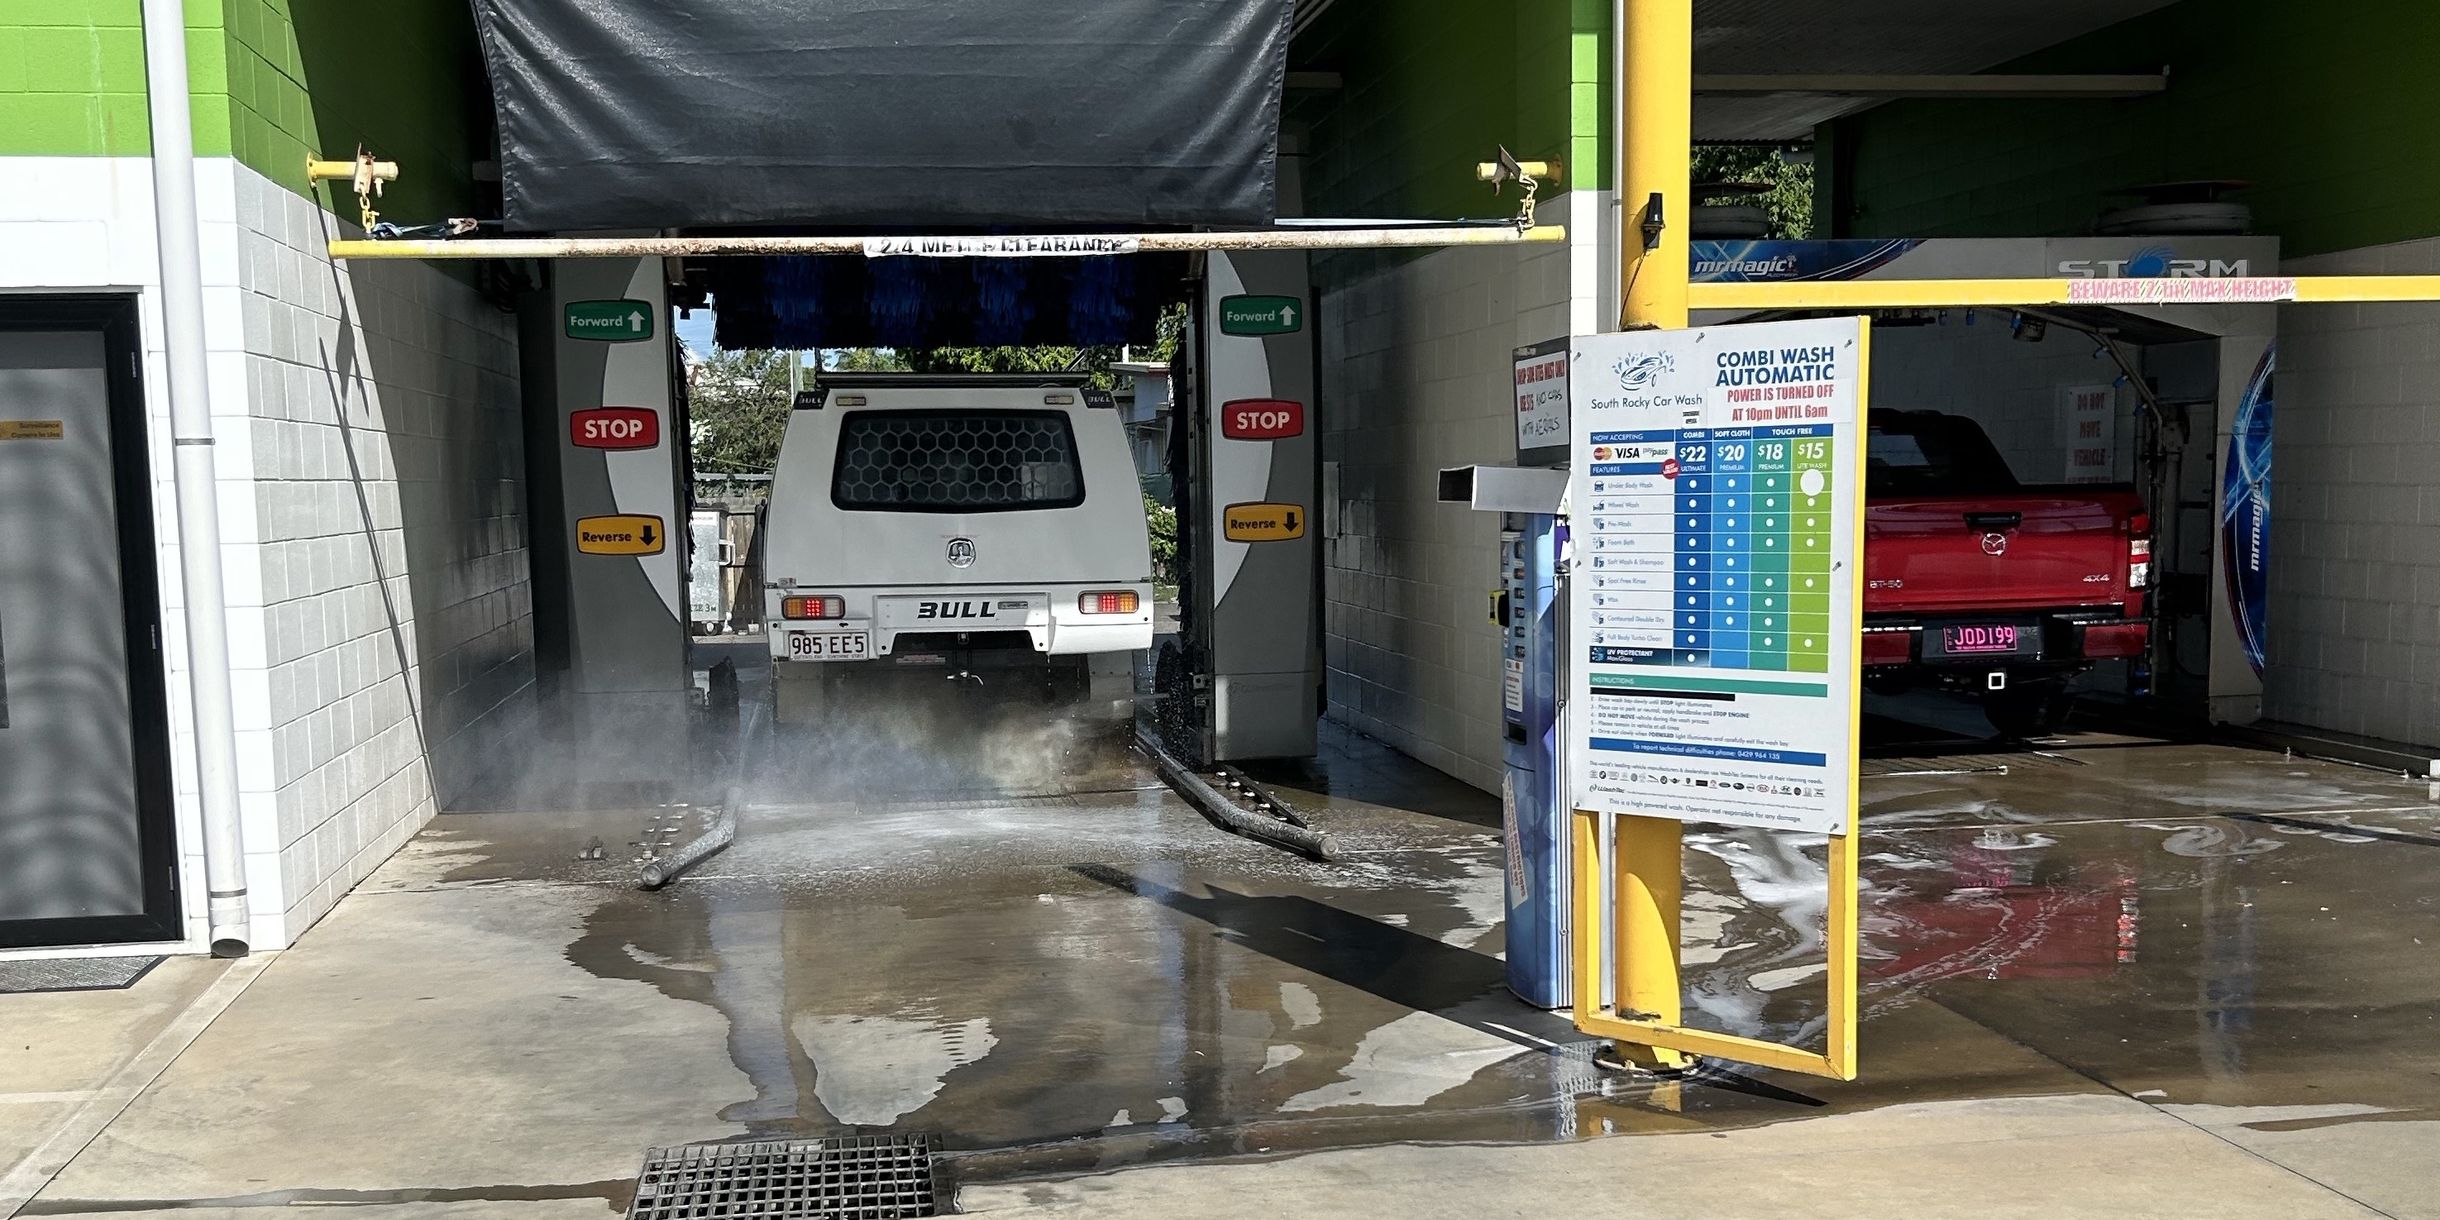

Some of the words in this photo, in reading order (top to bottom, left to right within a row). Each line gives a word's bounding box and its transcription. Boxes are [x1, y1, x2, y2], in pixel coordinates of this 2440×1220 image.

[1695, 256, 1787, 276] mrmagic
[2071, 280, 2140, 299] BEWARE
[2190, 280, 2226, 297] MAX
[2232, 280, 2292, 297] HEIGHT
[571, 315, 623, 327] Forward
[1227, 311, 1275, 322] Forward
[1717, 349, 1774, 368] COMBI
[1780, 346, 1834, 364] WASH
[1716, 363, 1834, 387] AUTOMATIC
[1591, 398, 1619, 409] South
[1622, 396, 1650, 409] Rocky
[1654, 396, 1672, 407] Car
[1675, 394, 1702, 406] Wash
[1728, 388, 1761, 403] POWER
[1764, 387, 1773, 401] IS
[1776, 385, 1814, 400] TURNED
[1817, 384, 1834, 398] OFF
[1236, 412, 1290, 430] STOP
[1732, 408, 1743, 422] AT
[1746, 407, 1772, 422] 10pm
[1775, 405, 1802, 420] UNTIL
[1805, 405, 1828, 418] 6am
[584, 419, 644, 439] STOP
[1610, 433, 1644, 441] ACCEPTING
[1683, 431, 1705, 439] COMBI
[1715, 430, 1730, 438] SOFT
[1772, 428, 1795, 436] TOUCH
[1615, 448, 1640, 459] VISA
[1680, 446, 1706, 462] $22
[1718, 444, 1744, 462] $20
[1758, 443, 1783, 460] $18
[1798, 442, 1824, 459] $15
[1231, 519, 1276, 530] Reverse
[582, 531, 632, 543] Reverse
[1870, 579, 1903, 588] BT-50
[918, 601, 996, 618] BULL
[792, 637, 822, 654] 985
[830, 636, 864, 653] EE5
[1641, 744, 1658, 752] report
[1660, 745, 1684, 753] technical
